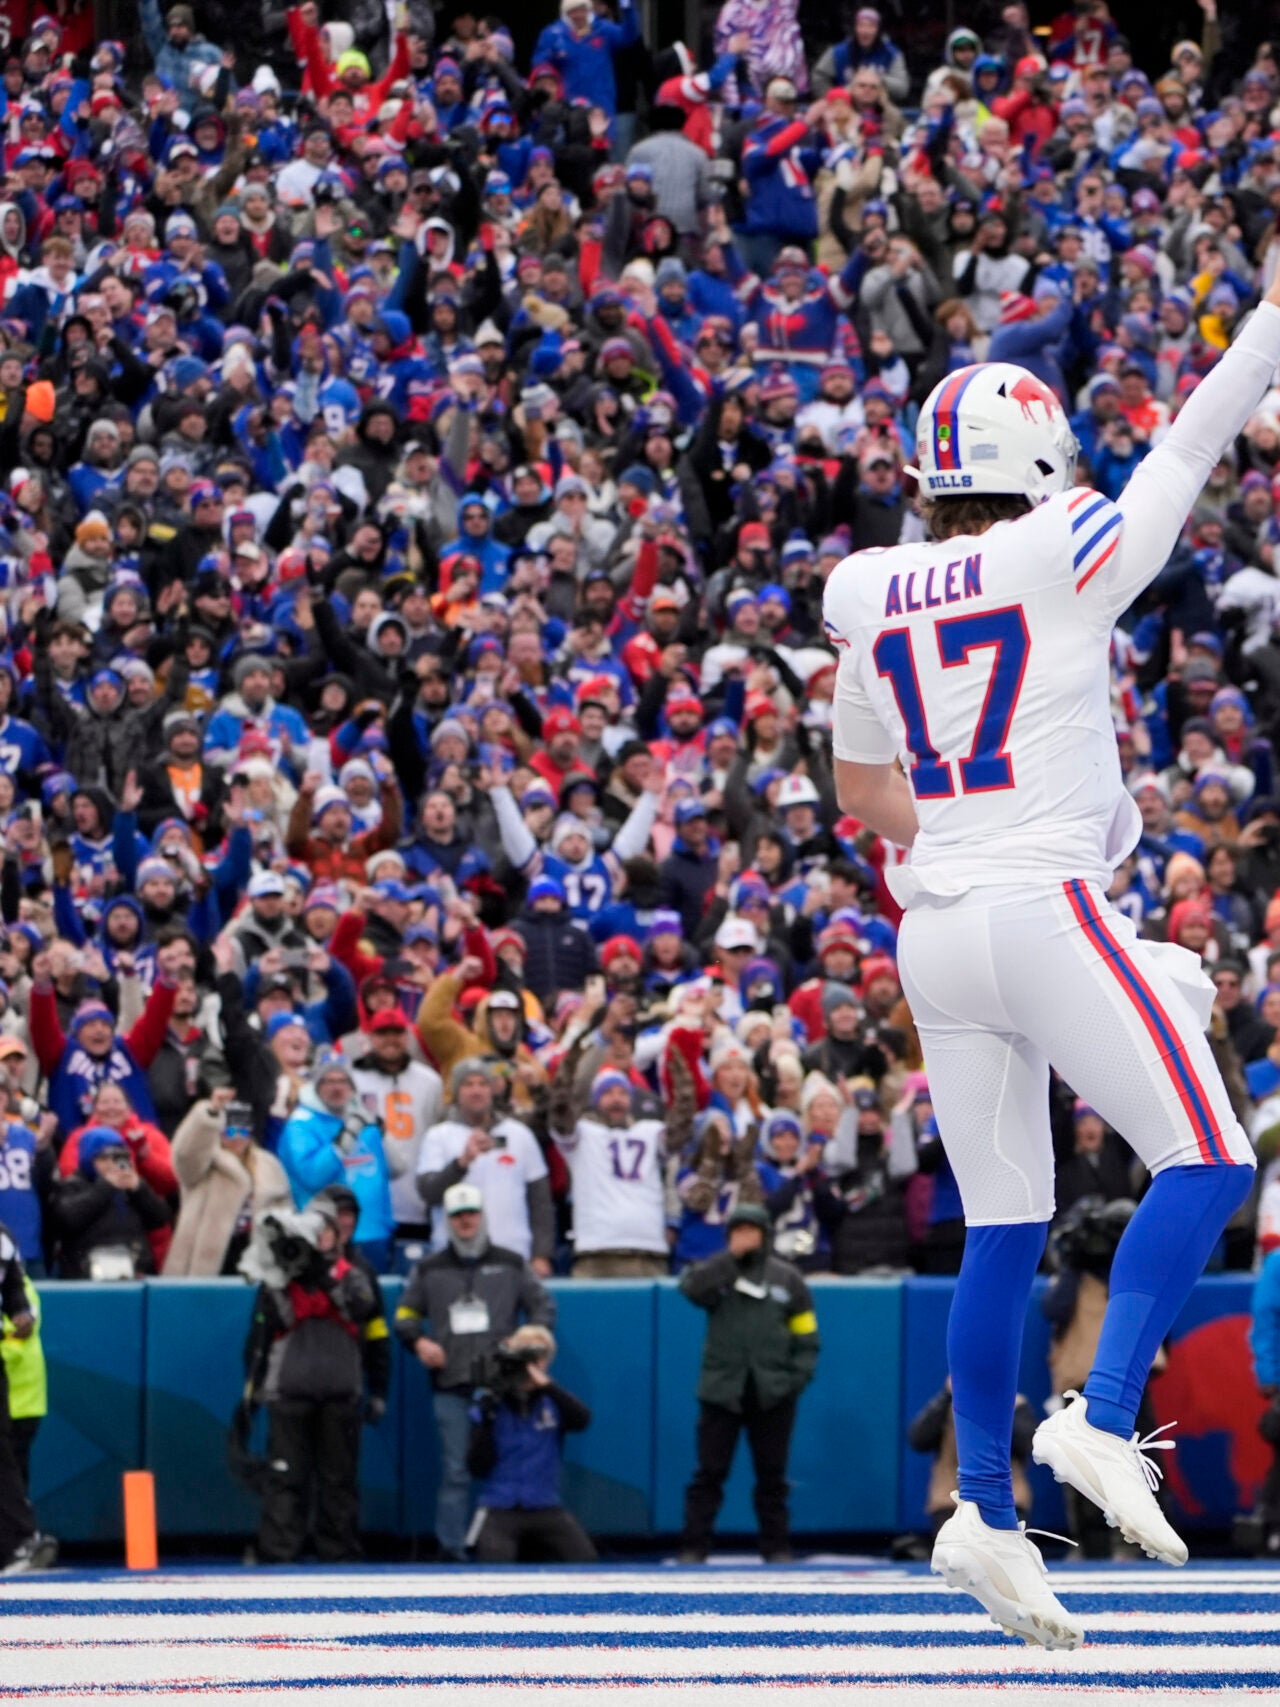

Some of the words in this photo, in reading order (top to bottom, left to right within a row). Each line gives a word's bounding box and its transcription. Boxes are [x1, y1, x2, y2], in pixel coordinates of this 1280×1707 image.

[928, 474, 972, 489] BILLS
[885, 553, 982, 617] ALLEN
[872, 604, 1031, 799] 17
[562, 873, 604, 912] 17
[386, 1092, 413, 1139] 6
[607, 1139, 646, 1181] 17
